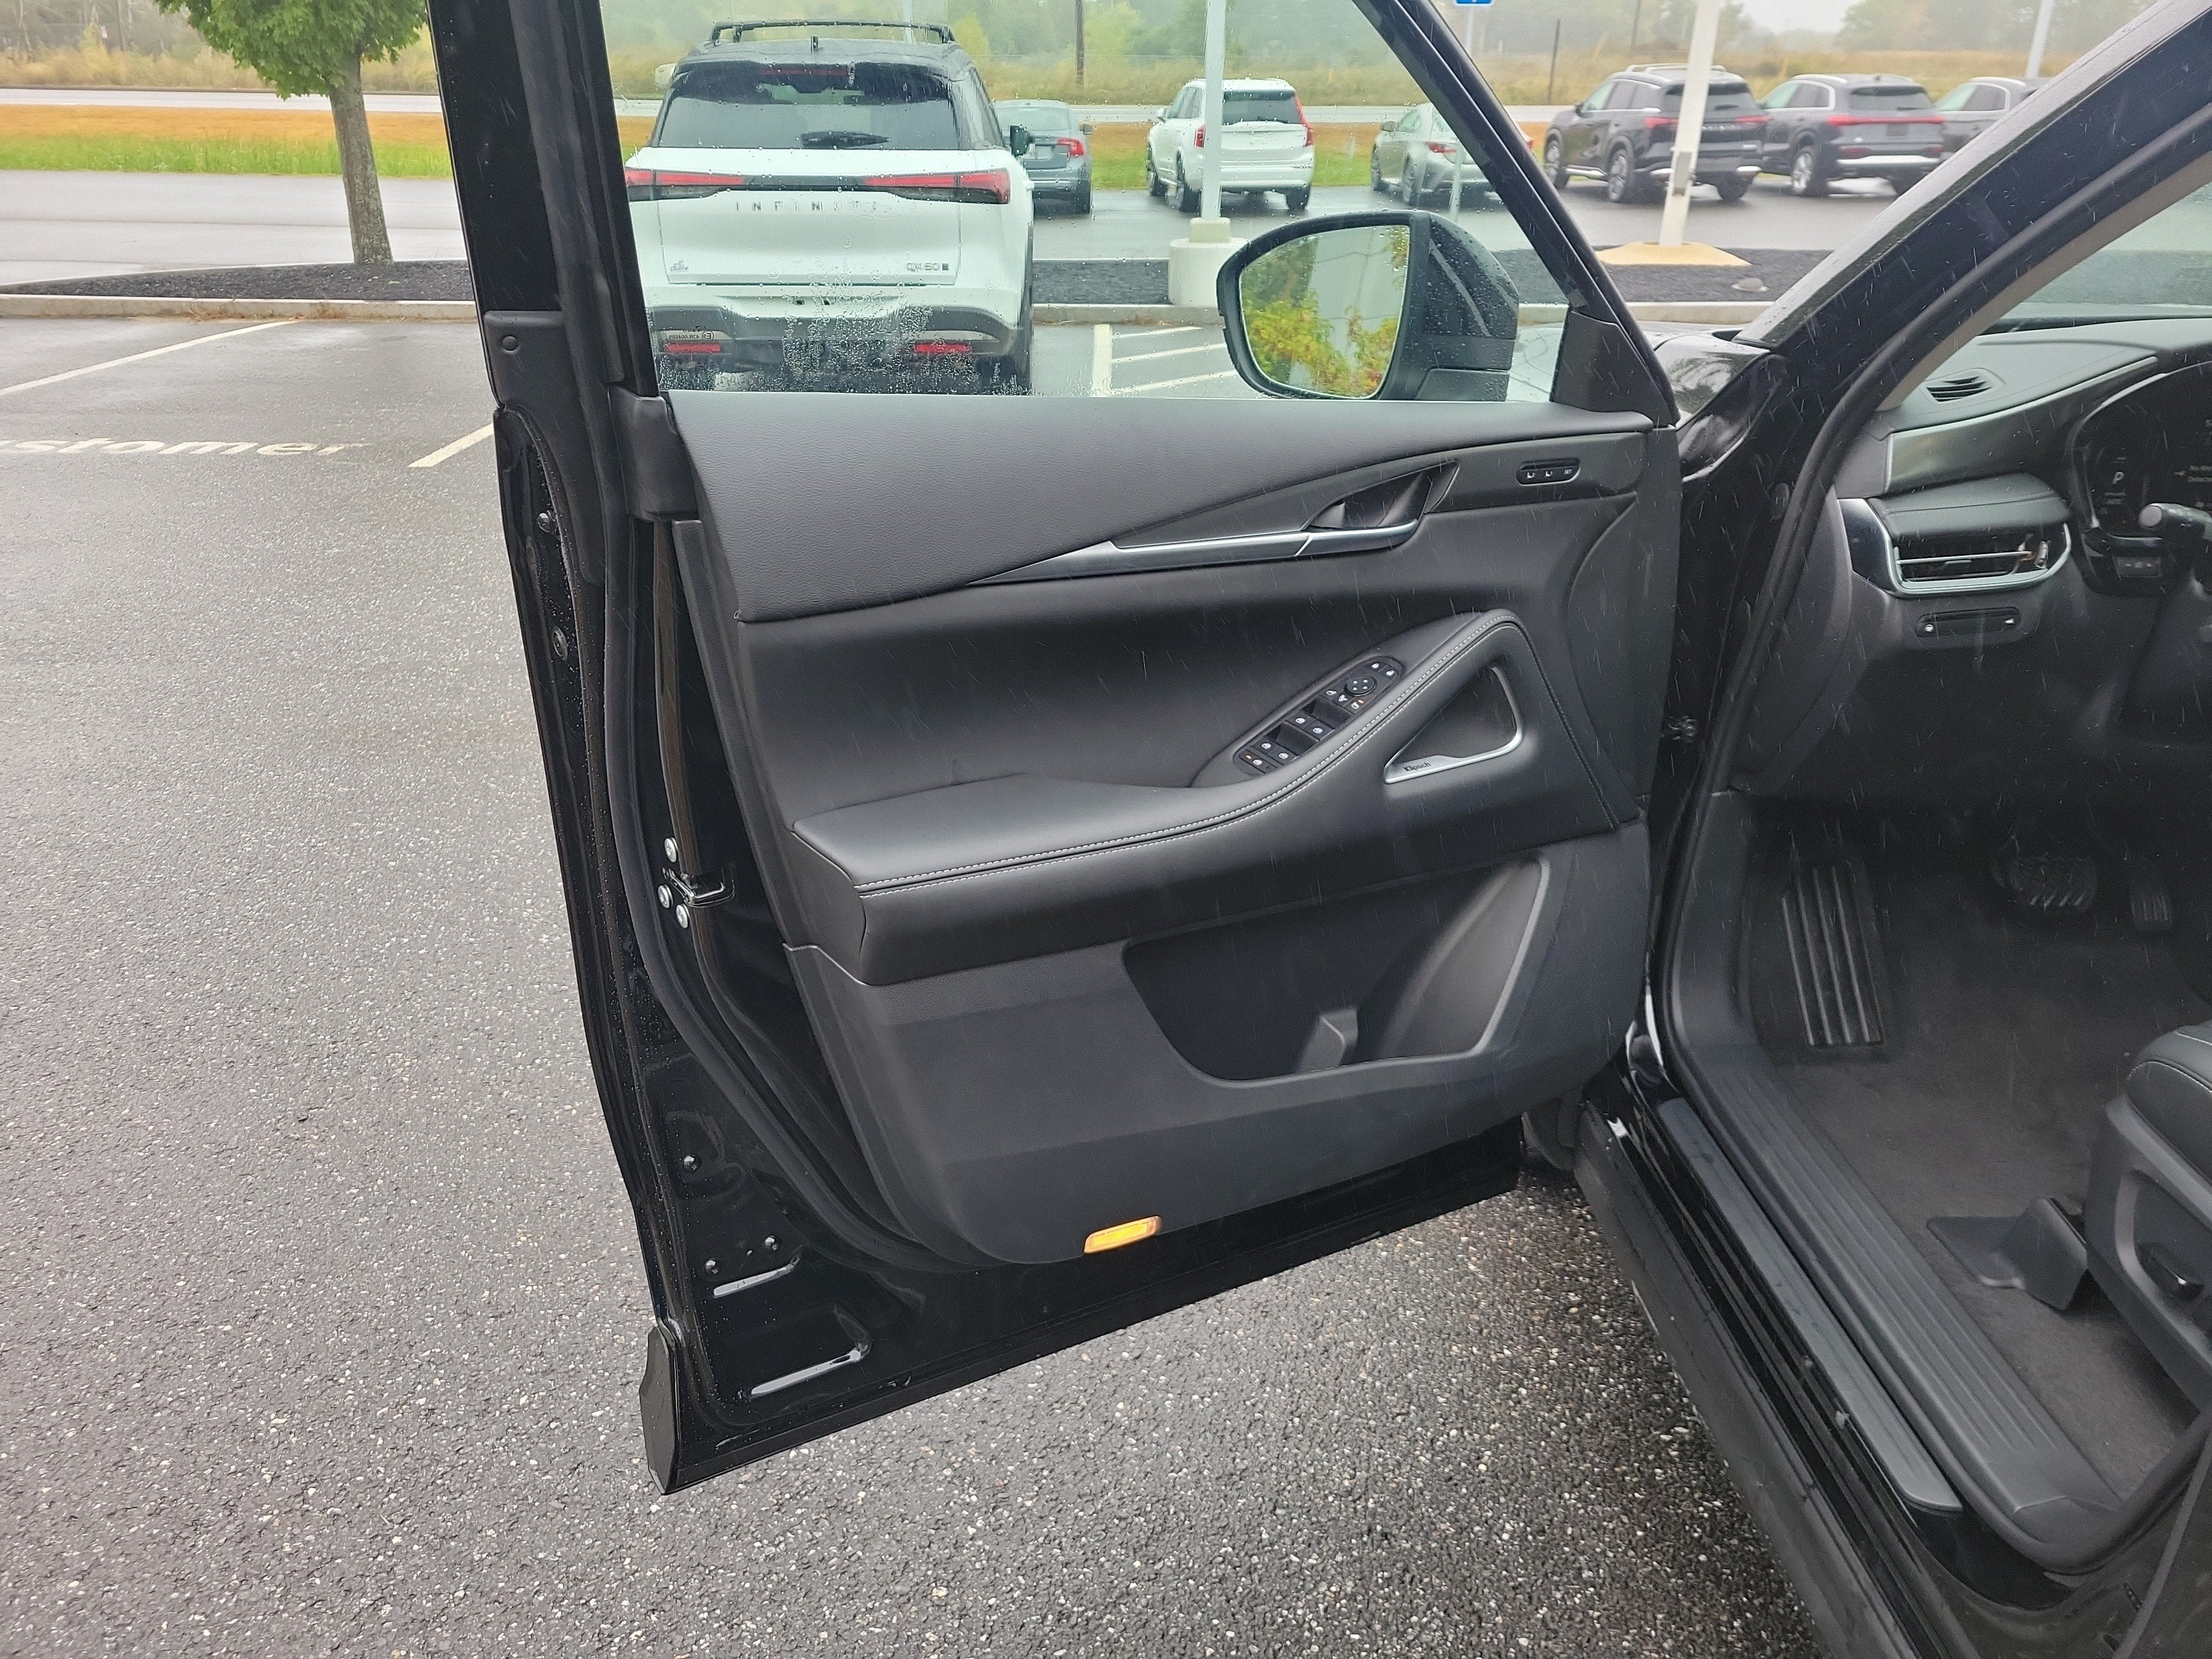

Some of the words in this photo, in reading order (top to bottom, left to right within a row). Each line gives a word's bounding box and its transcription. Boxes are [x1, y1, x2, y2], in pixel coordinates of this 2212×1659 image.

[0, 437, 370, 455] stomer
[2112, 471, 2125, 484] P
[1402, 761, 1431, 772] Klipsch
